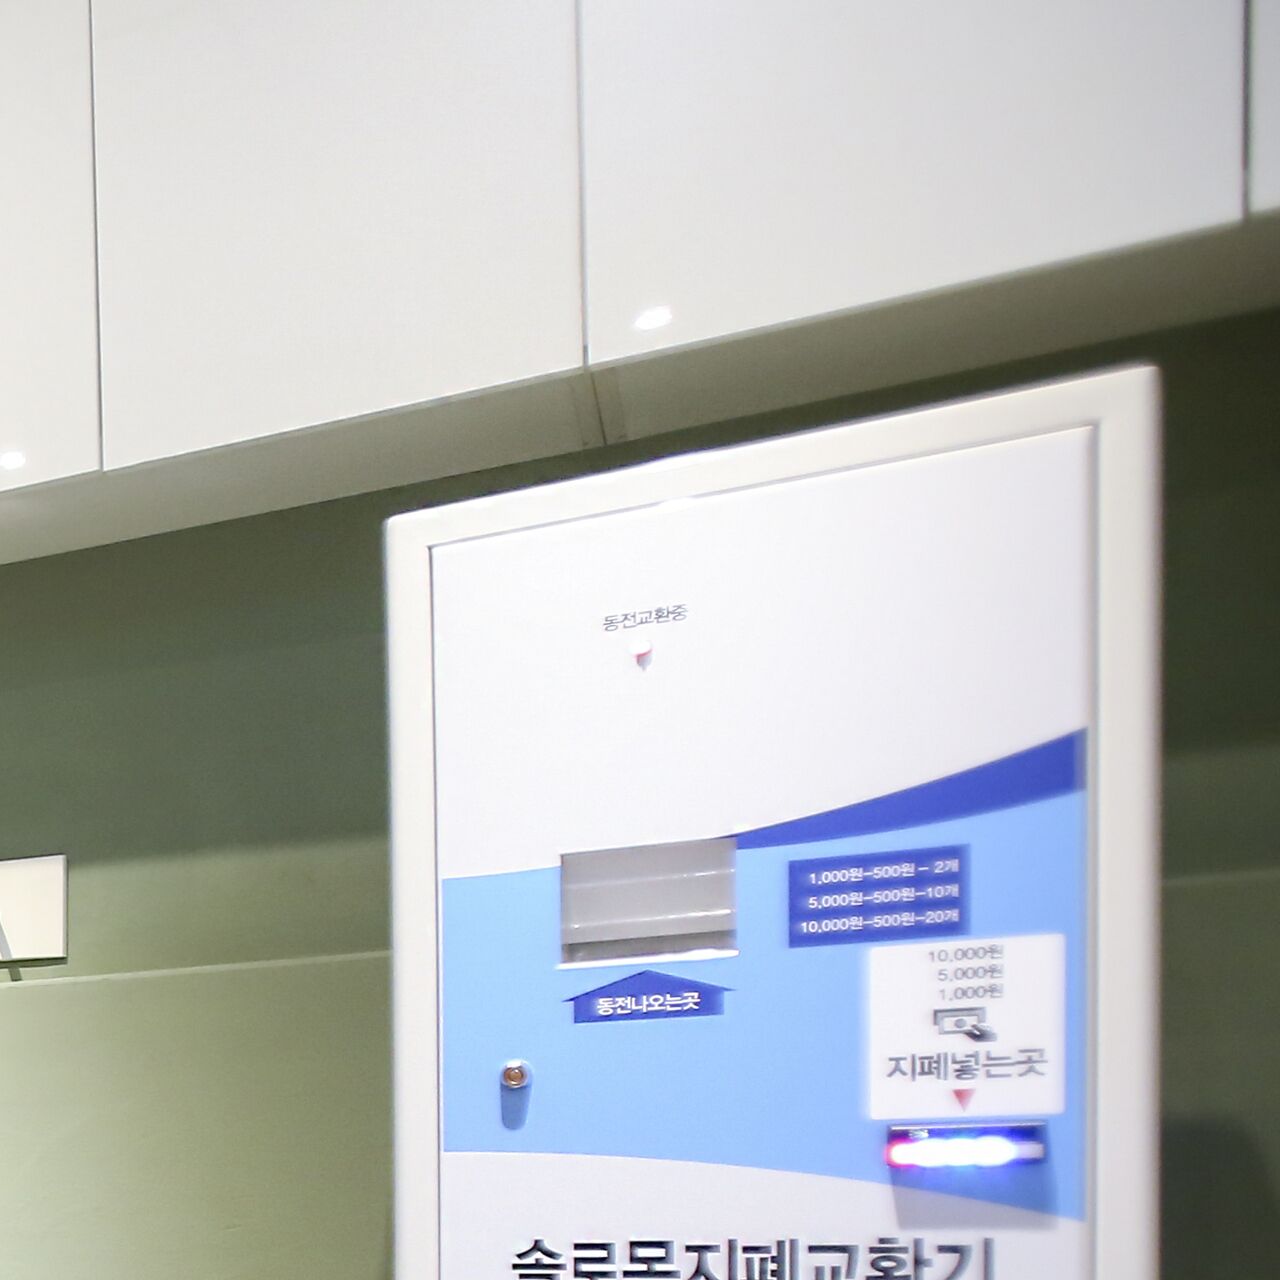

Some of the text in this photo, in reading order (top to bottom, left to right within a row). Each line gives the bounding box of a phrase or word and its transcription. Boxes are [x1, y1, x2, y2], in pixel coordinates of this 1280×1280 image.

[603, 604, 688, 632] 동전교환중
[934, 859, 959, 874] 2개
[929, 944, 1004, 963] 10,000원
[937, 964, 1004, 982] 5,000원
[939, 983, 1004, 1001] 1,000원
[597, 992, 701, 1016] 동전나오는곳
[886, 1048, 1048, 1081] 지폐넣는곳
